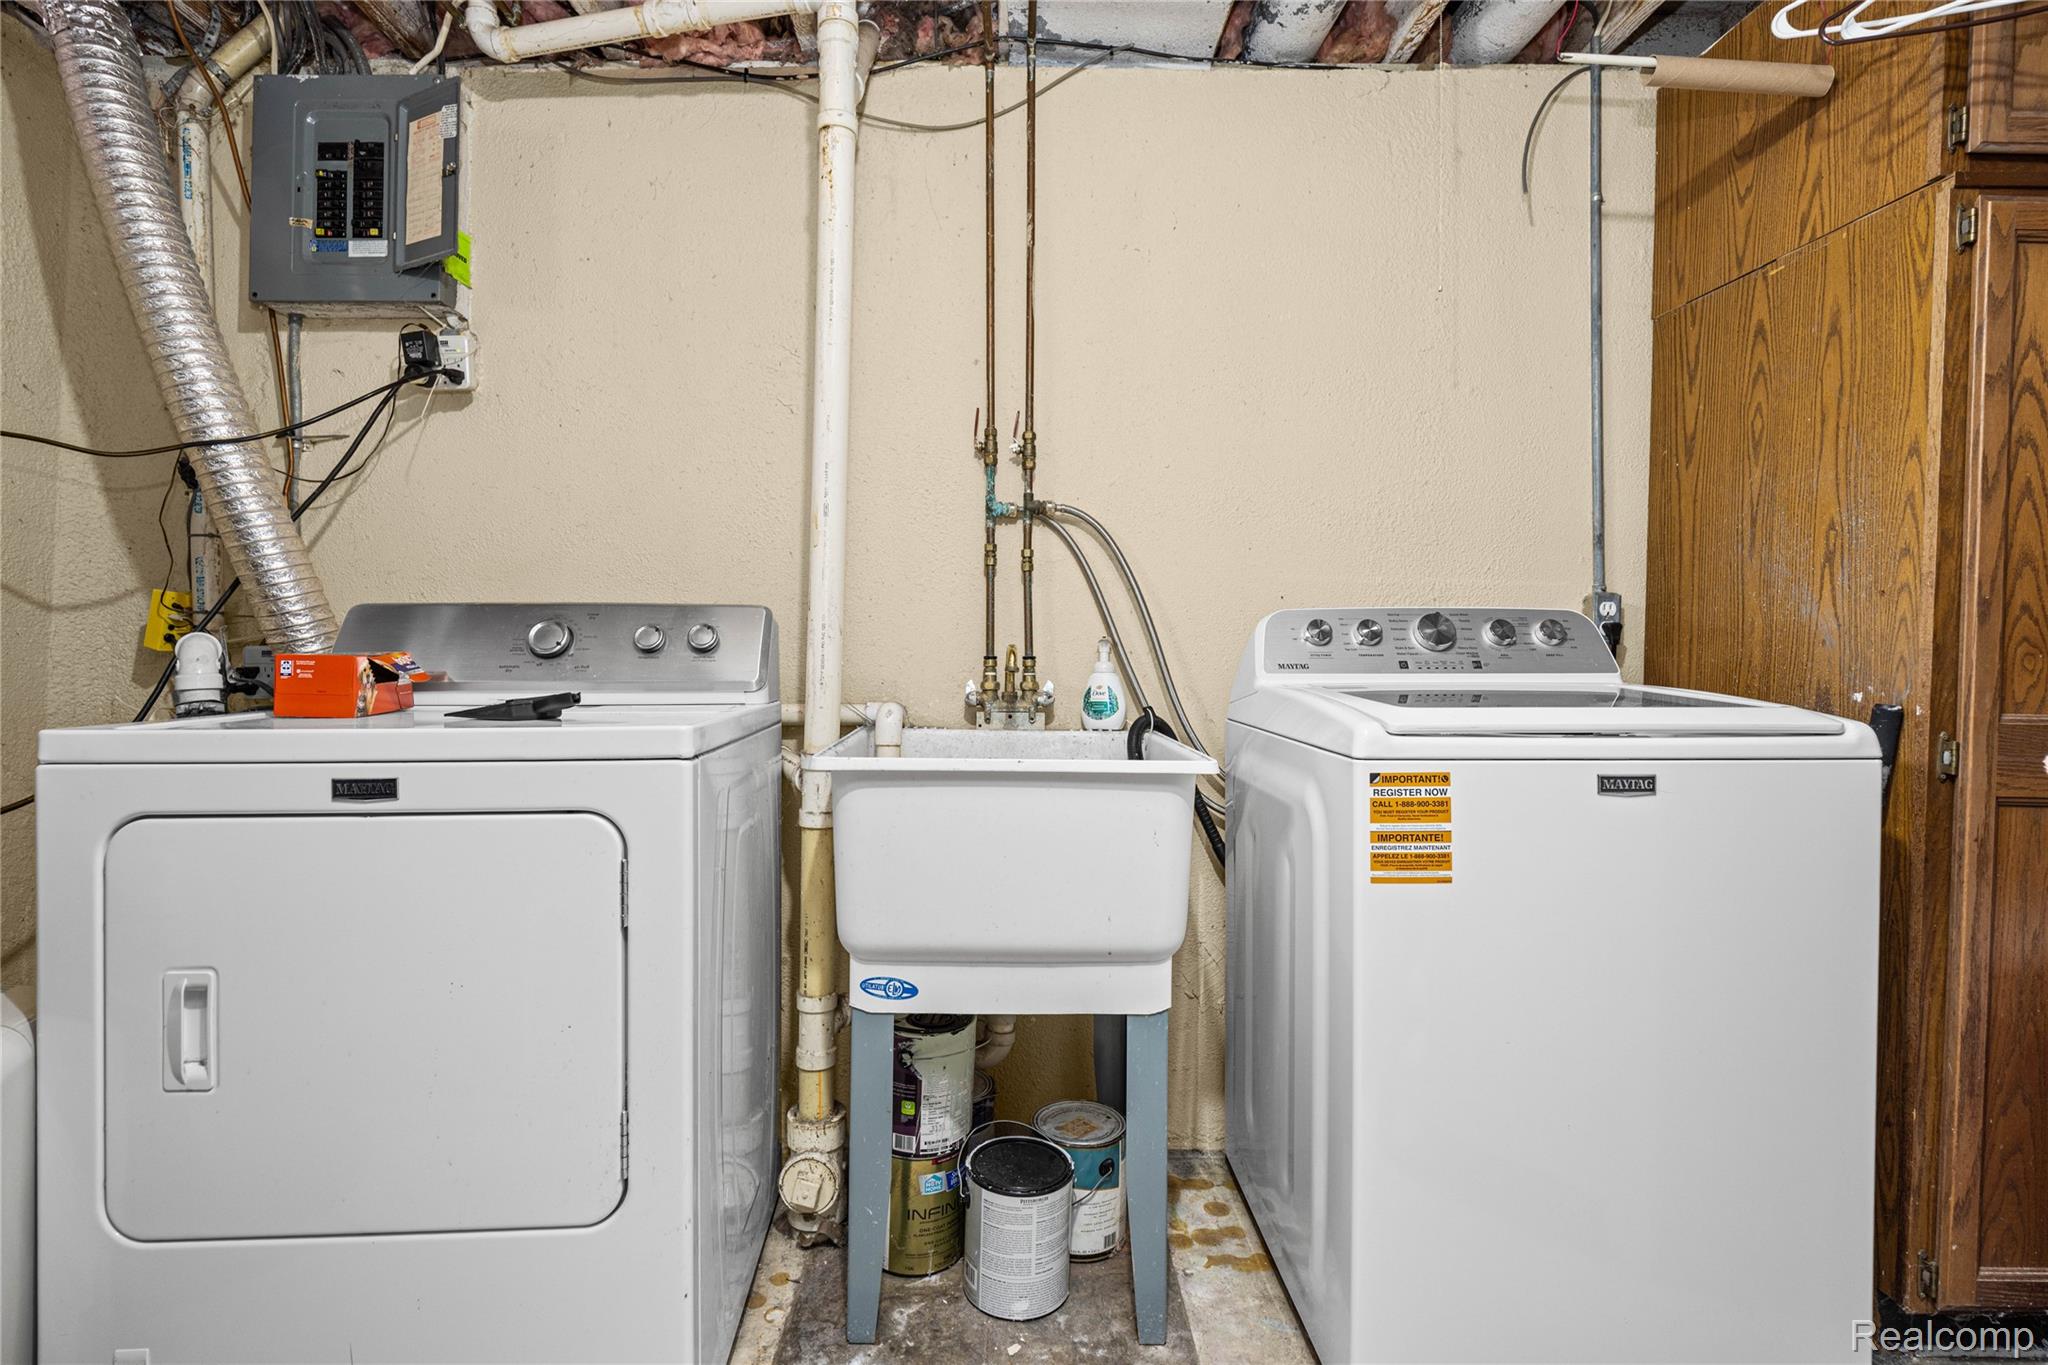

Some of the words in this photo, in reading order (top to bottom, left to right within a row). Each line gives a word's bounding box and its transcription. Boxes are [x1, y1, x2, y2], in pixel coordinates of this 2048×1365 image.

[1381, 775, 1440, 784] IMPORTANT!
[335, 783, 394, 795] MAYTAG
[1602, 779, 1654, 790] MAYTAG
[1373, 788, 1422, 797] REGISTER
[1424, 788, 1448, 796] NOW
[1395, 800, 1449, 808] 1-888-900-3381
[1377, 833, 1444, 842] IMPORTANTE!
